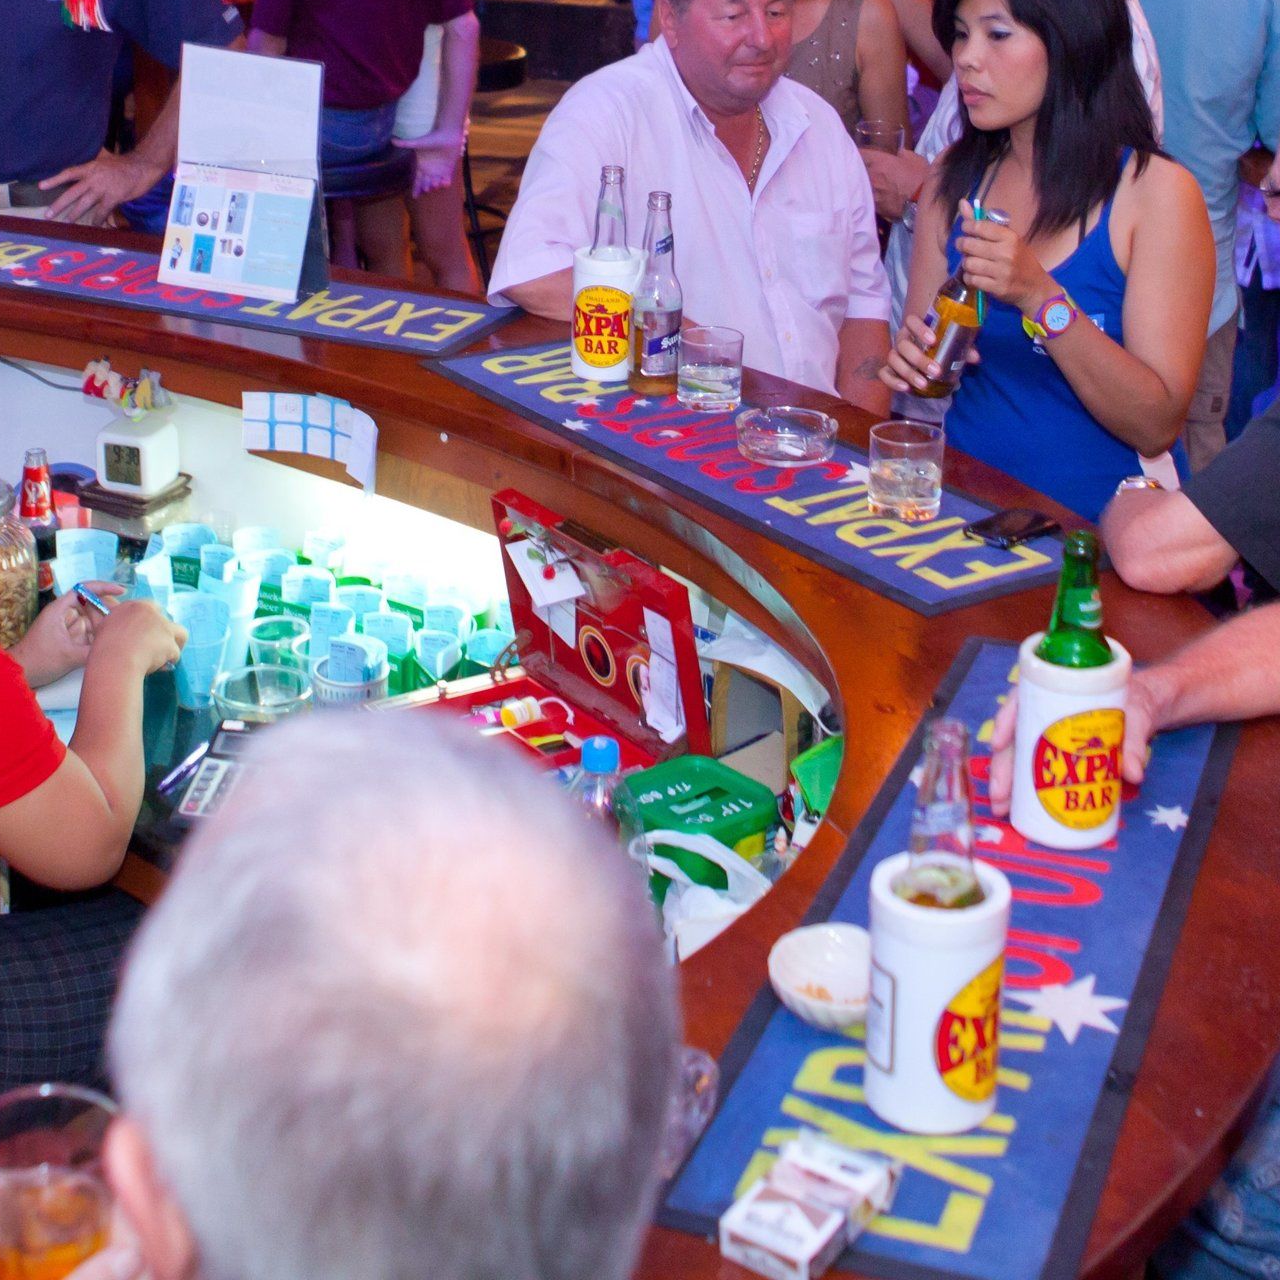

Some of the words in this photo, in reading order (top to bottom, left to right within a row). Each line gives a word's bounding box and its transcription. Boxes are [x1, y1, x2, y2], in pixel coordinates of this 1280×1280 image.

[583, 338, 620, 355] BAR
[1034, 741, 1122, 789] EXPA
[1063, 785, 1114, 814] BAR
